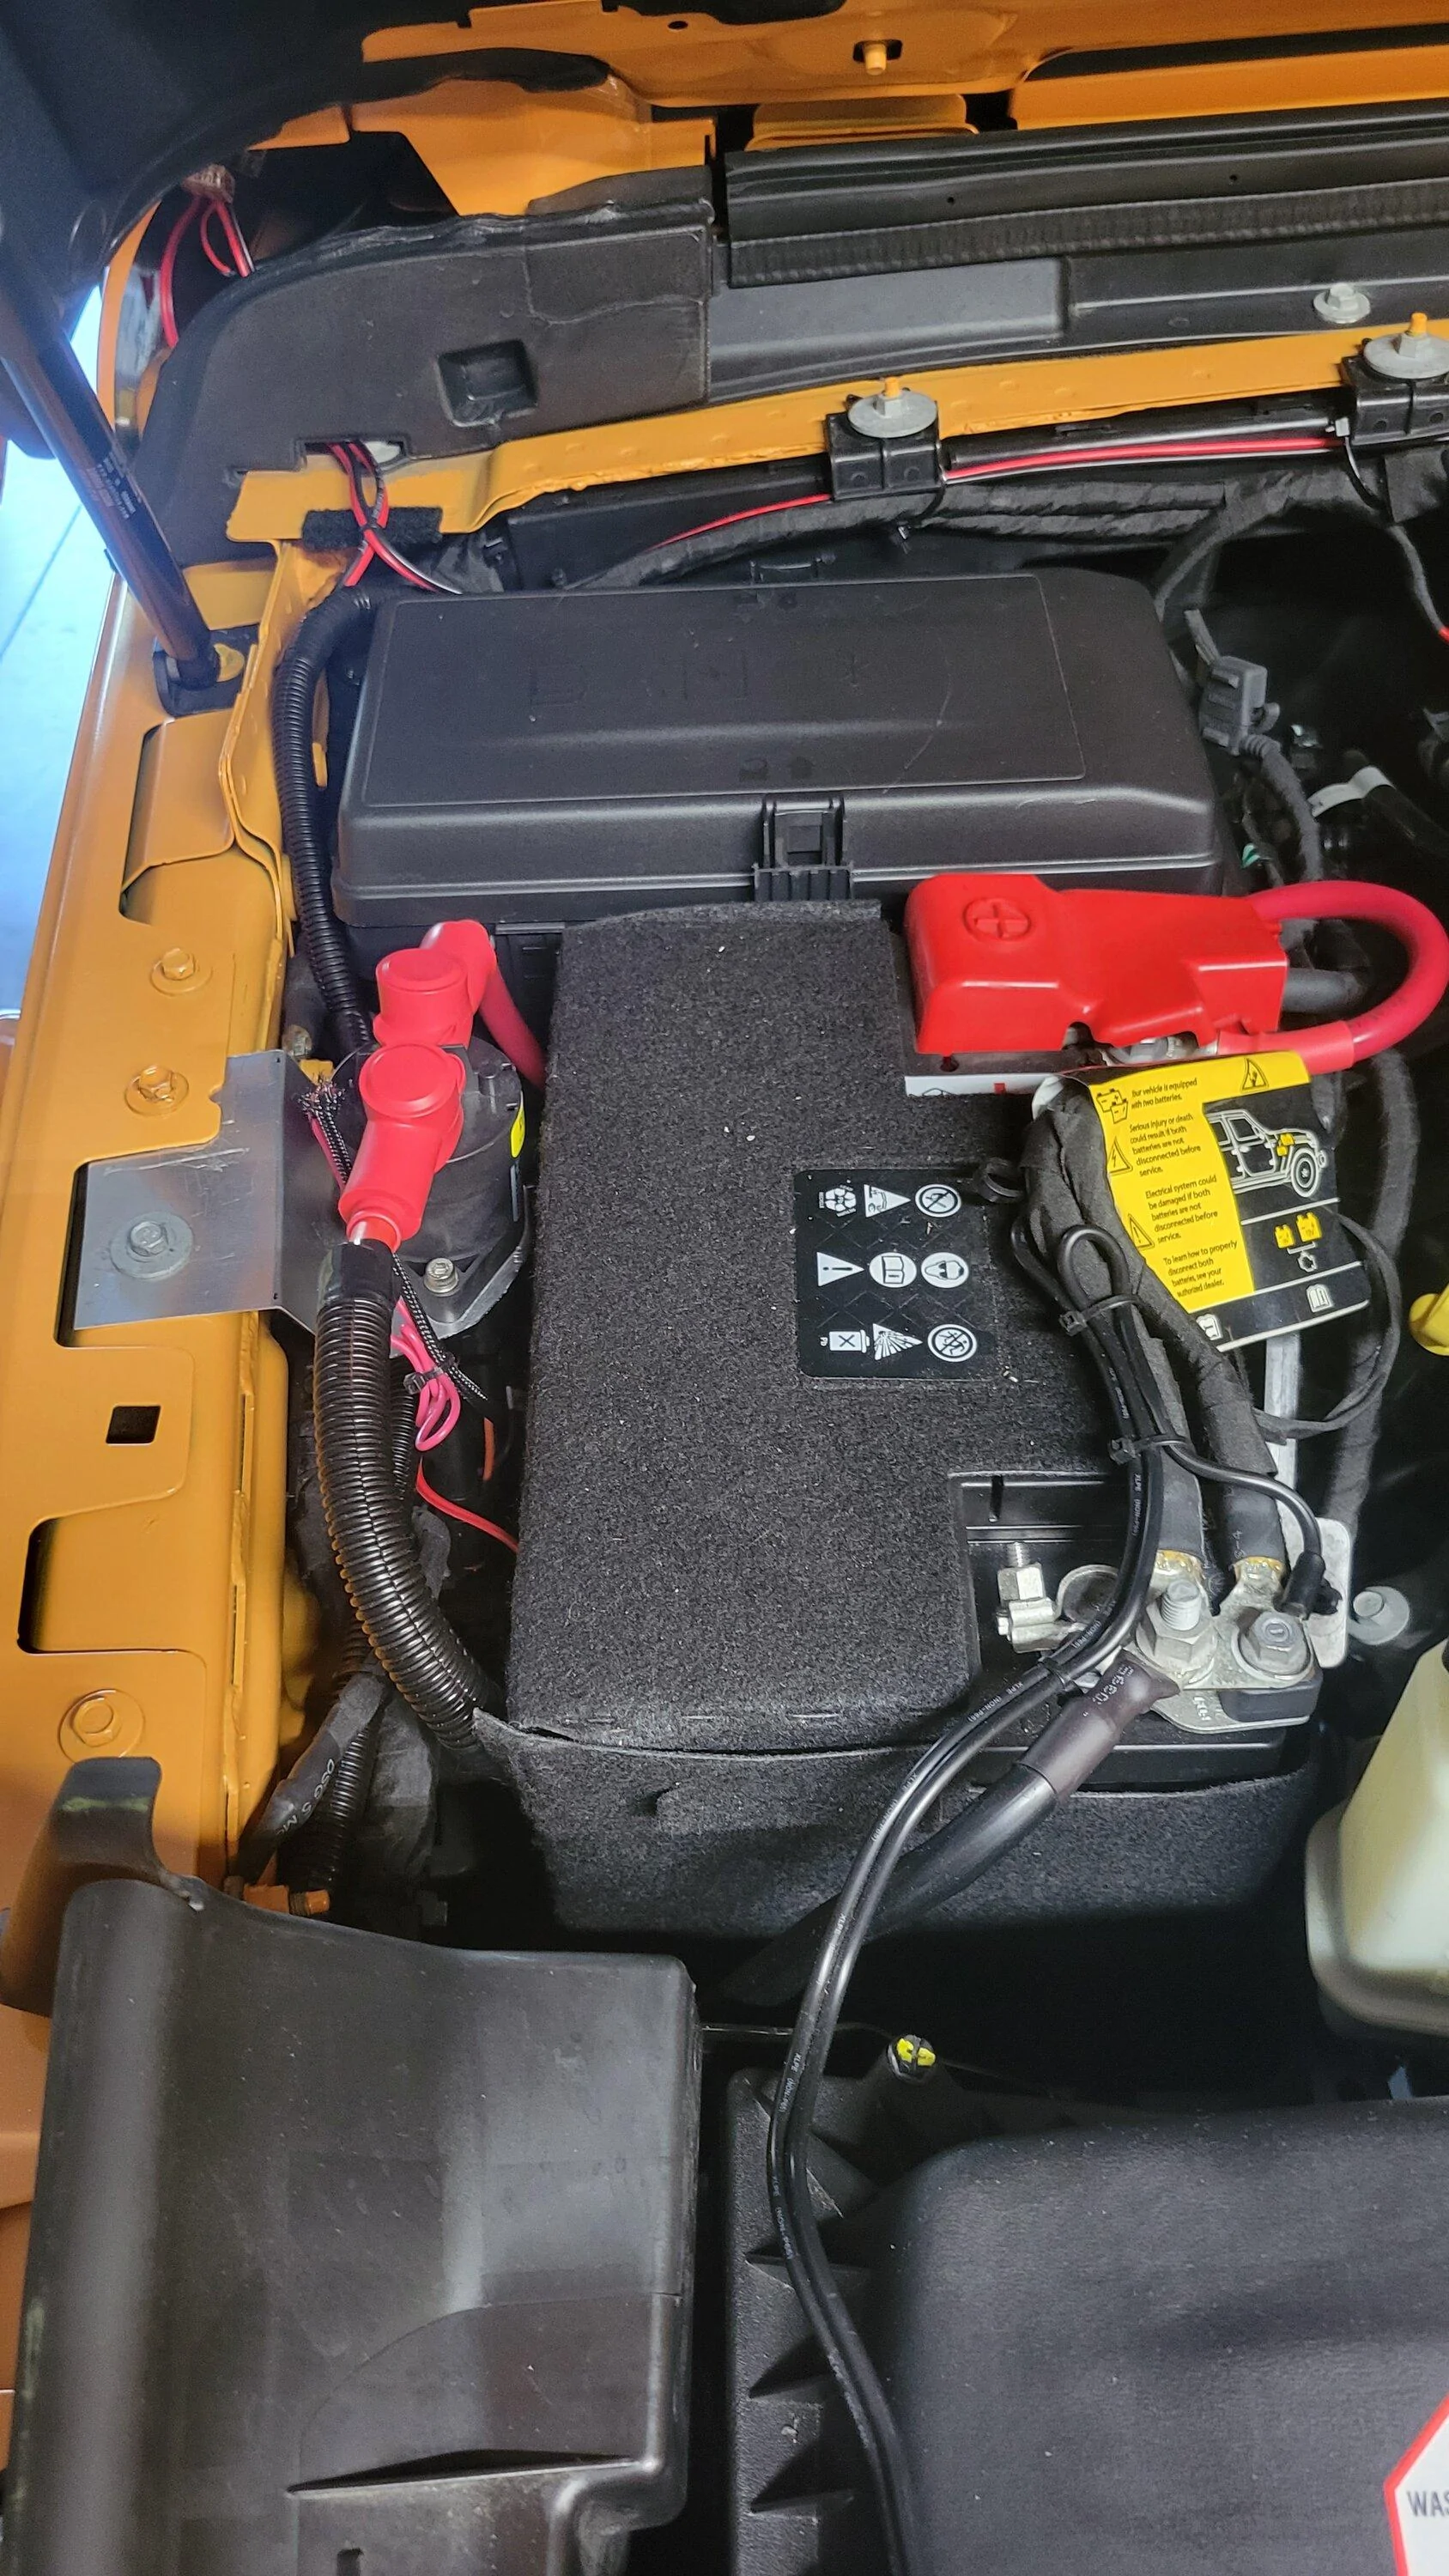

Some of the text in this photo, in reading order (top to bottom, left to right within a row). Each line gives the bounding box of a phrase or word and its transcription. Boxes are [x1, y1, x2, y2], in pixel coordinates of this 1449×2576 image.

[1143, 1085, 1163, 1095] vehicle
[1169, 1078, 1197, 1091] equipped
[1155, 1095, 1182, 1103] batteries.
[1130, 1121, 1149, 1133] Serious
[1150, 1118, 1167, 1128] injury
[1176, 1114, 1193, 1122] death
[1131, 1133, 1147, 1144] could
[1148, 1131, 1165, 1140] result
[1171, 1126, 1186, 1135] both
[1132, 1144, 1161, 1155] batteries
[1137, 1145, 1201, 1166] disconnected before
[1140, 1166, 1163, 1176] service.
[1146, 1176, 1216, 1199] Electrical system could
[1159, 1195, 1186, 1207] damaged
[1194, 1189, 1210, 1198] both
[1151, 1209, 1178, 1221] batteries
[1155, 1211, 1218, 1232] disconnected before
[1157, 1233, 1181, 1243] service.
[1163, 1257, 1172, 1266] To
[1173, 1255, 1187, 1263] learn
[1210, 1240, 1237, 1254] properly
[1168, 1258, 1214, 1276] disconnect both
[1208, 1268, 1222, 1278] your
[1204, 1279, 1224, 1289] dealer.
[1005, 1680, 1023, 1695] XLPE
[791, 2052, 802, 2072] XLPE
